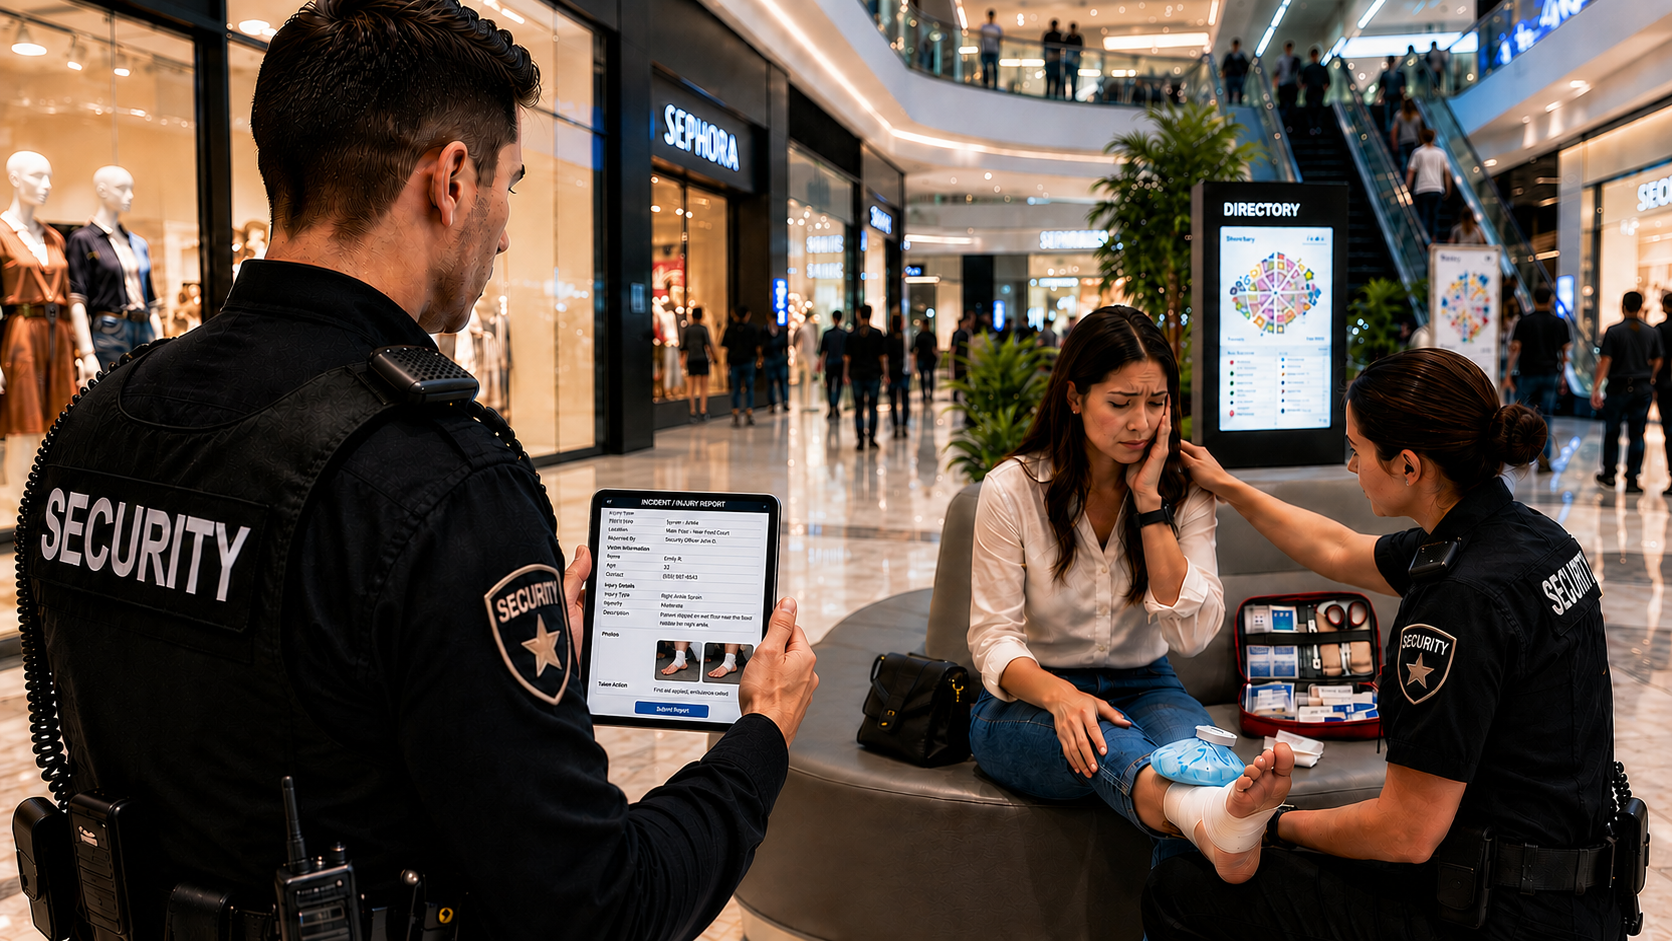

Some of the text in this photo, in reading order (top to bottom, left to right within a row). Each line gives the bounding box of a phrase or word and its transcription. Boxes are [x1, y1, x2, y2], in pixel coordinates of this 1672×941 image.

[664, 103, 740, 172] SEPHORA
[1223, 202, 1300, 217] DIRECTORY
[641, 498, 671, 506] INCIDENT
[41, 487, 251, 602] SECURITY
[496, 580, 559, 623] SECURITY
[1542, 550, 1596, 616] SECURITY
[1402, 634, 1449, 656] SECURITY
